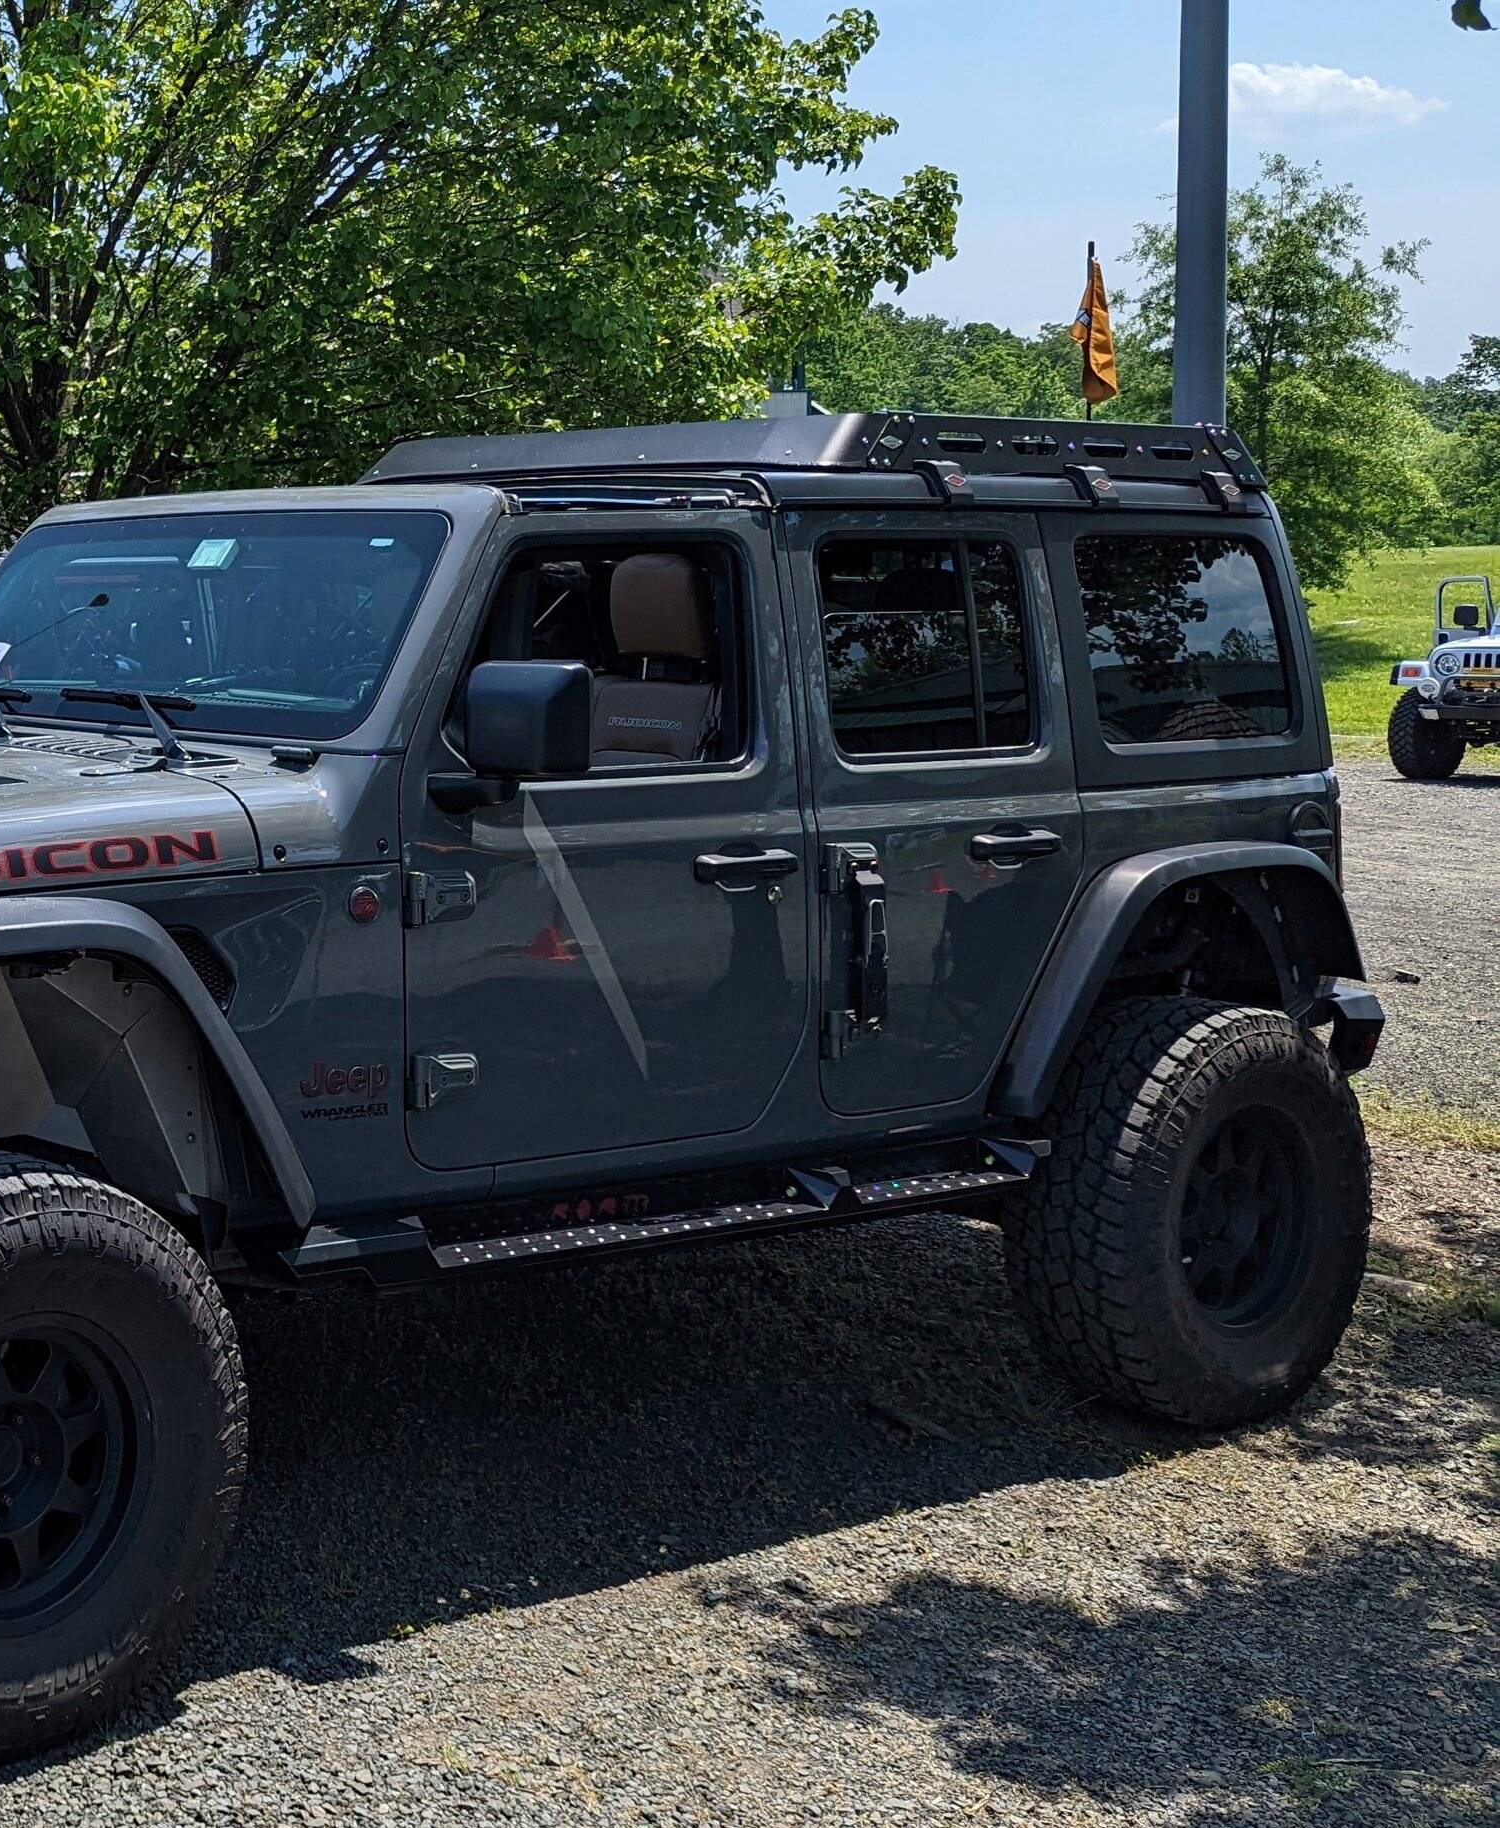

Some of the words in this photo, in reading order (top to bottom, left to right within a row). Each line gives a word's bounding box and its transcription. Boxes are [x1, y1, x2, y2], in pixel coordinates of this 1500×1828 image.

[607, 716, 683, 731] RUBICON
[300, 1058, 388, 1101] Jeep
[300, 1102, 389, 1120] WRANGLER
